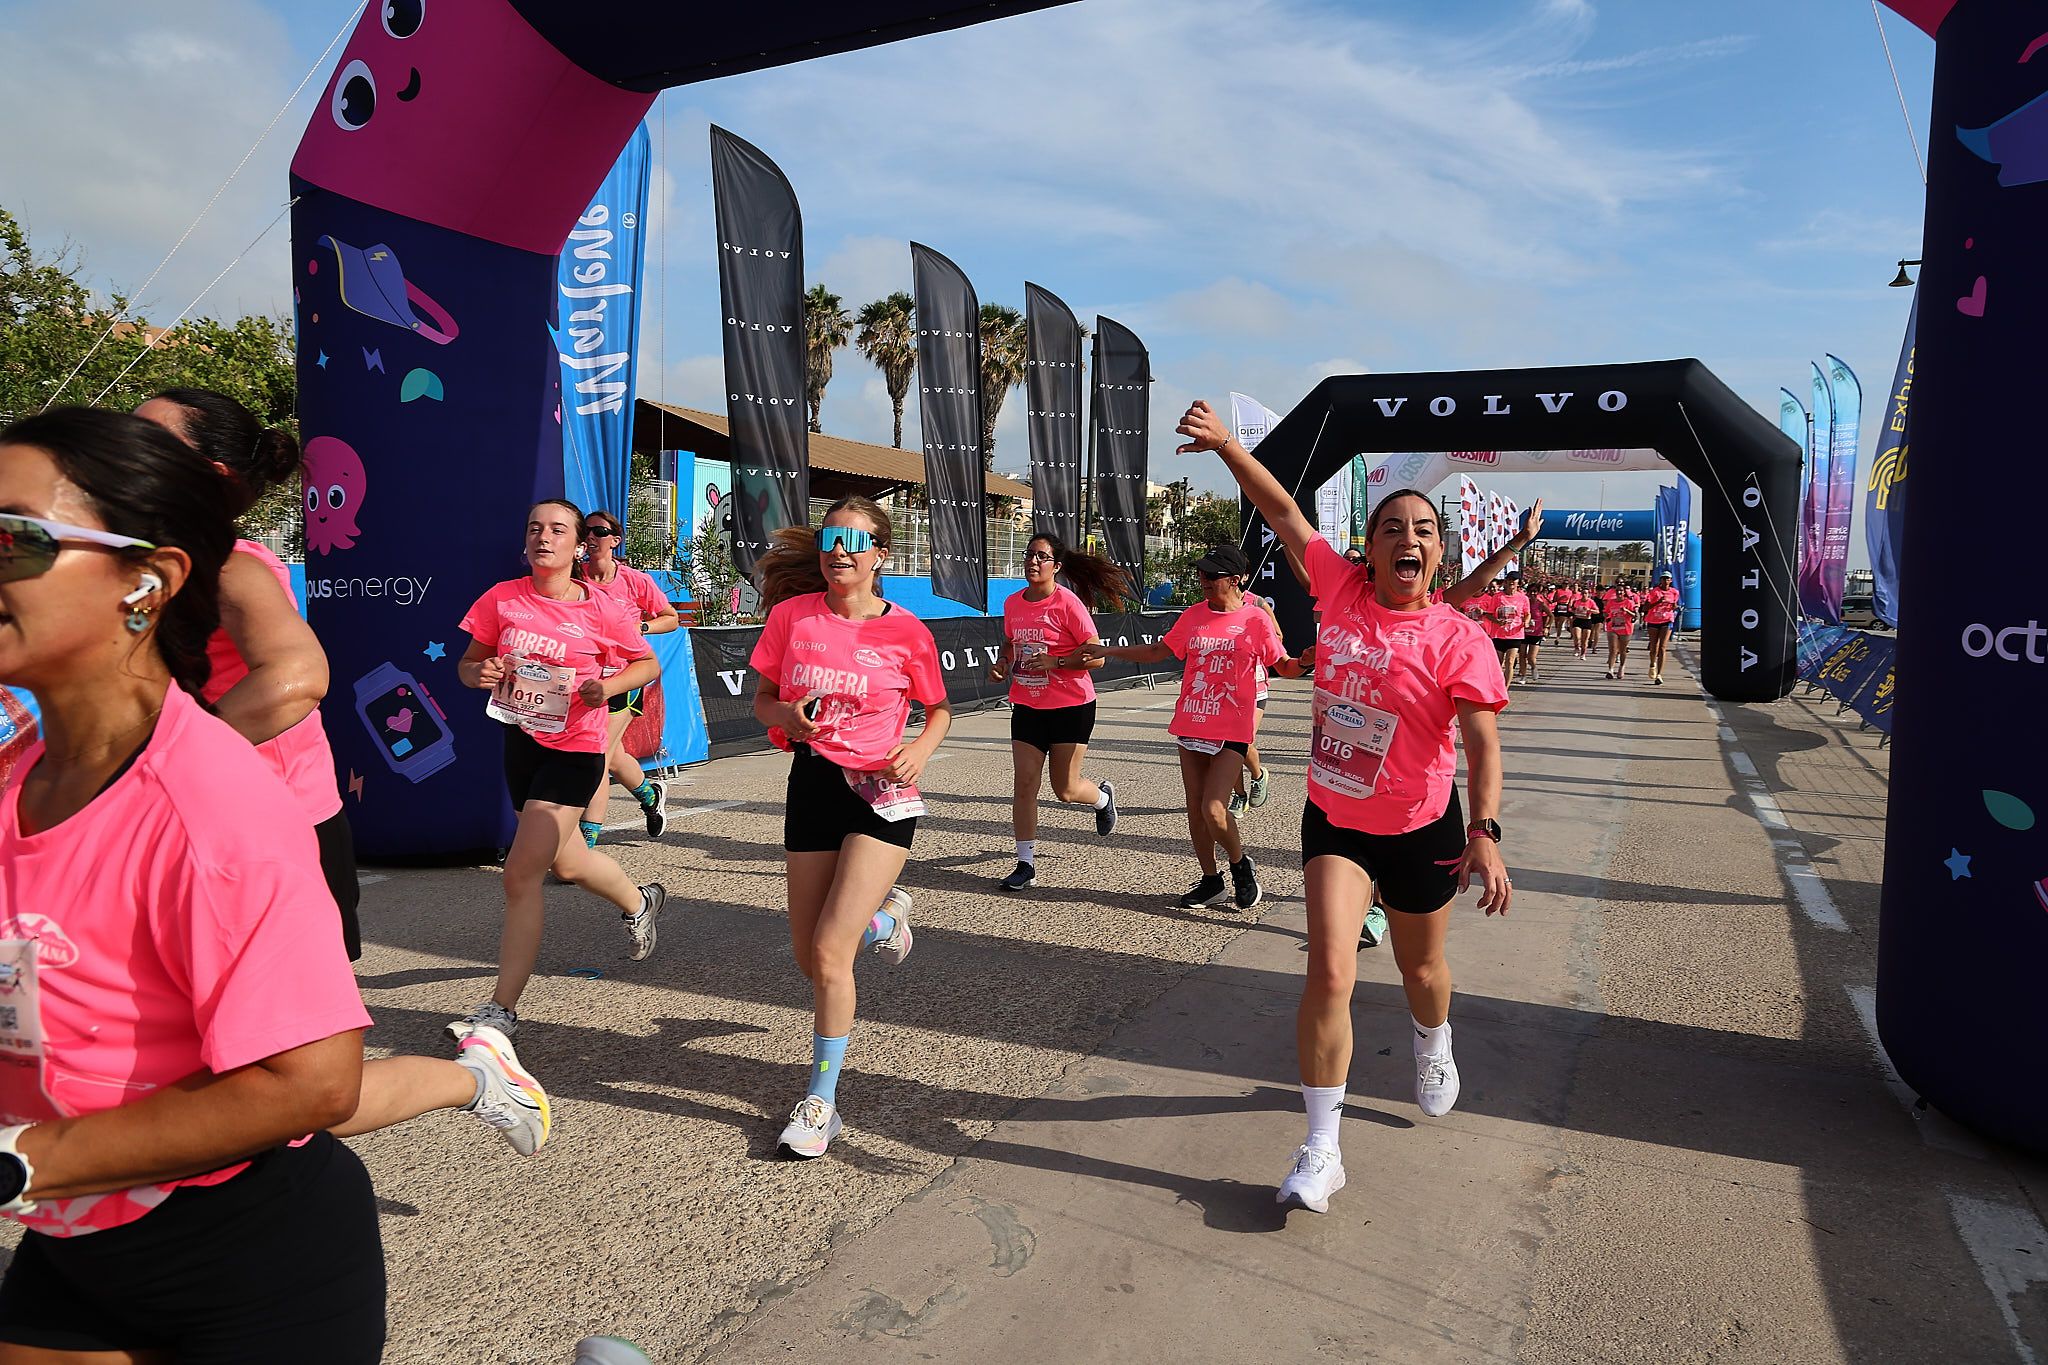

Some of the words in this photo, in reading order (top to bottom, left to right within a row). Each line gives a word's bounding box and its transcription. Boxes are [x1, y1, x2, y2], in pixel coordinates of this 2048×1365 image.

[1373, 390, 1627, 417] VOLVO
[1565, 512, 1623, 537] Marlene
[1741, 486, 1761, 673] VOLVO
[793, 641, 827, 652] OYSHO
[1189, 636, 1236, 652] CARRERA
[1962, 620, 2048, 664] oct
[792, 664, 868, 699] CARRERA
[514, 689, 545, 705] 016
[1182, 699, 1221, 716] MUJER
[1329, 708, 1363, 727] ASTURIANA
[1320, 736, 1354, 759] 016
[1334, 780, 1363, 796] Santander
